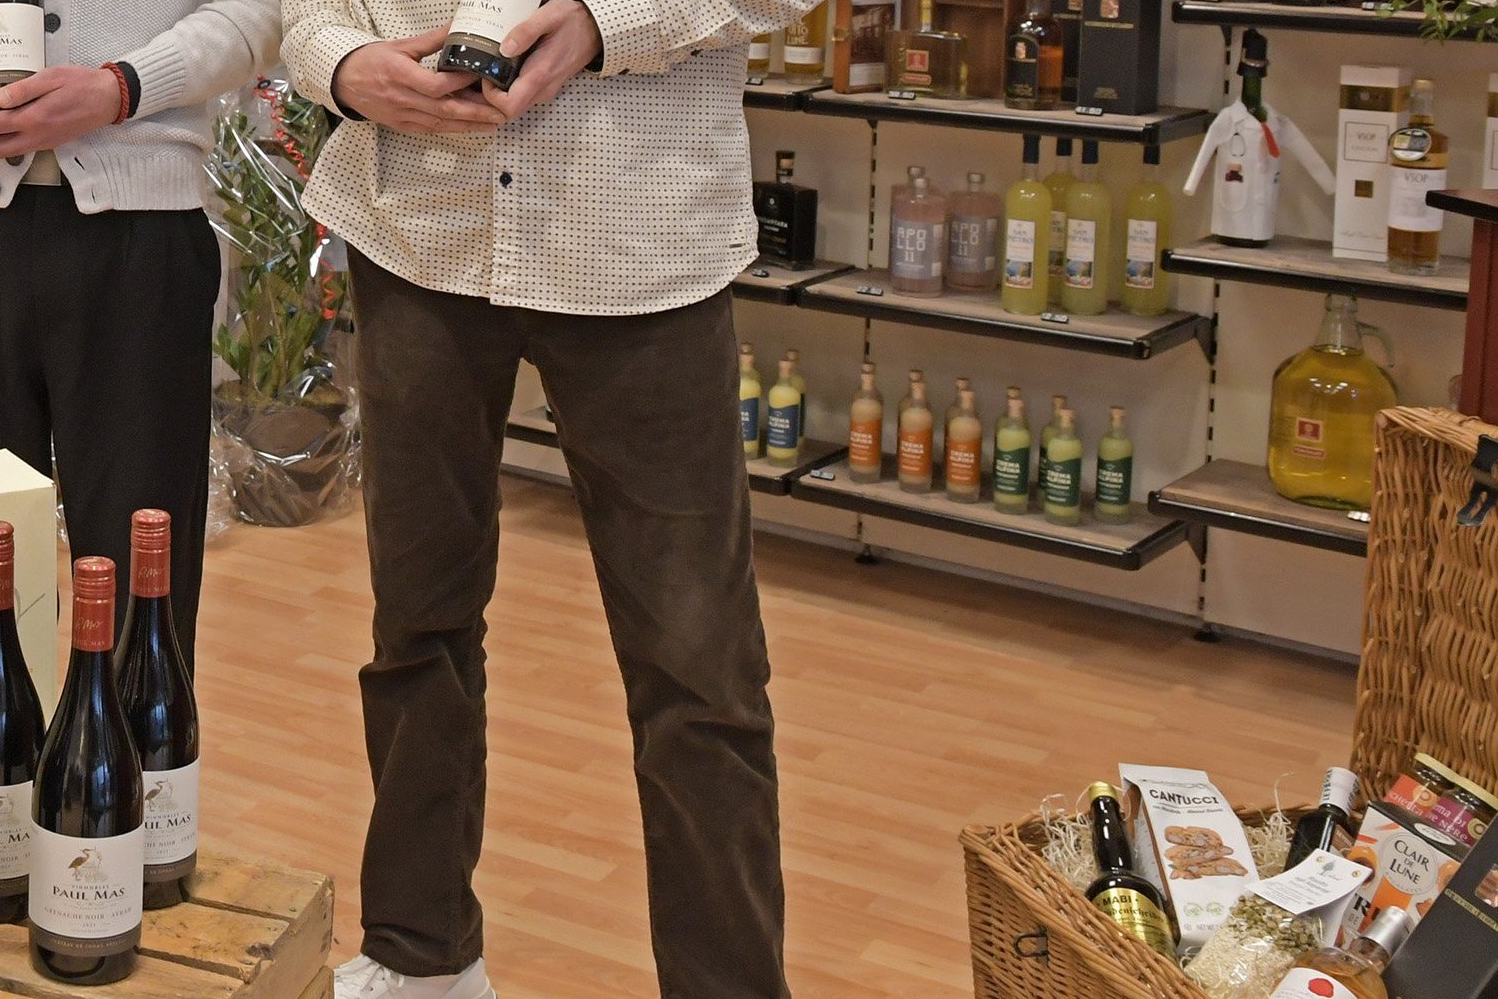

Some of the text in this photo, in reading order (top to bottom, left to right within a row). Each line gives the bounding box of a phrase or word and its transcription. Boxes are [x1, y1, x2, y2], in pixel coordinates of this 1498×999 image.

[0, 37, 23, 45] MAS
[1404, 171, 1429, 183] VSOP
[1149, 789, 1219, 805] CANTUCCI
[166, 815, 192, 829] MAS
[1394, 839, 1430, 873] CLAIR
[1389, 858, 1421, 885] LUNE
[53, 885, 126, 901] PAUL MAS
[1102, 895, 1132, 906] MABI
